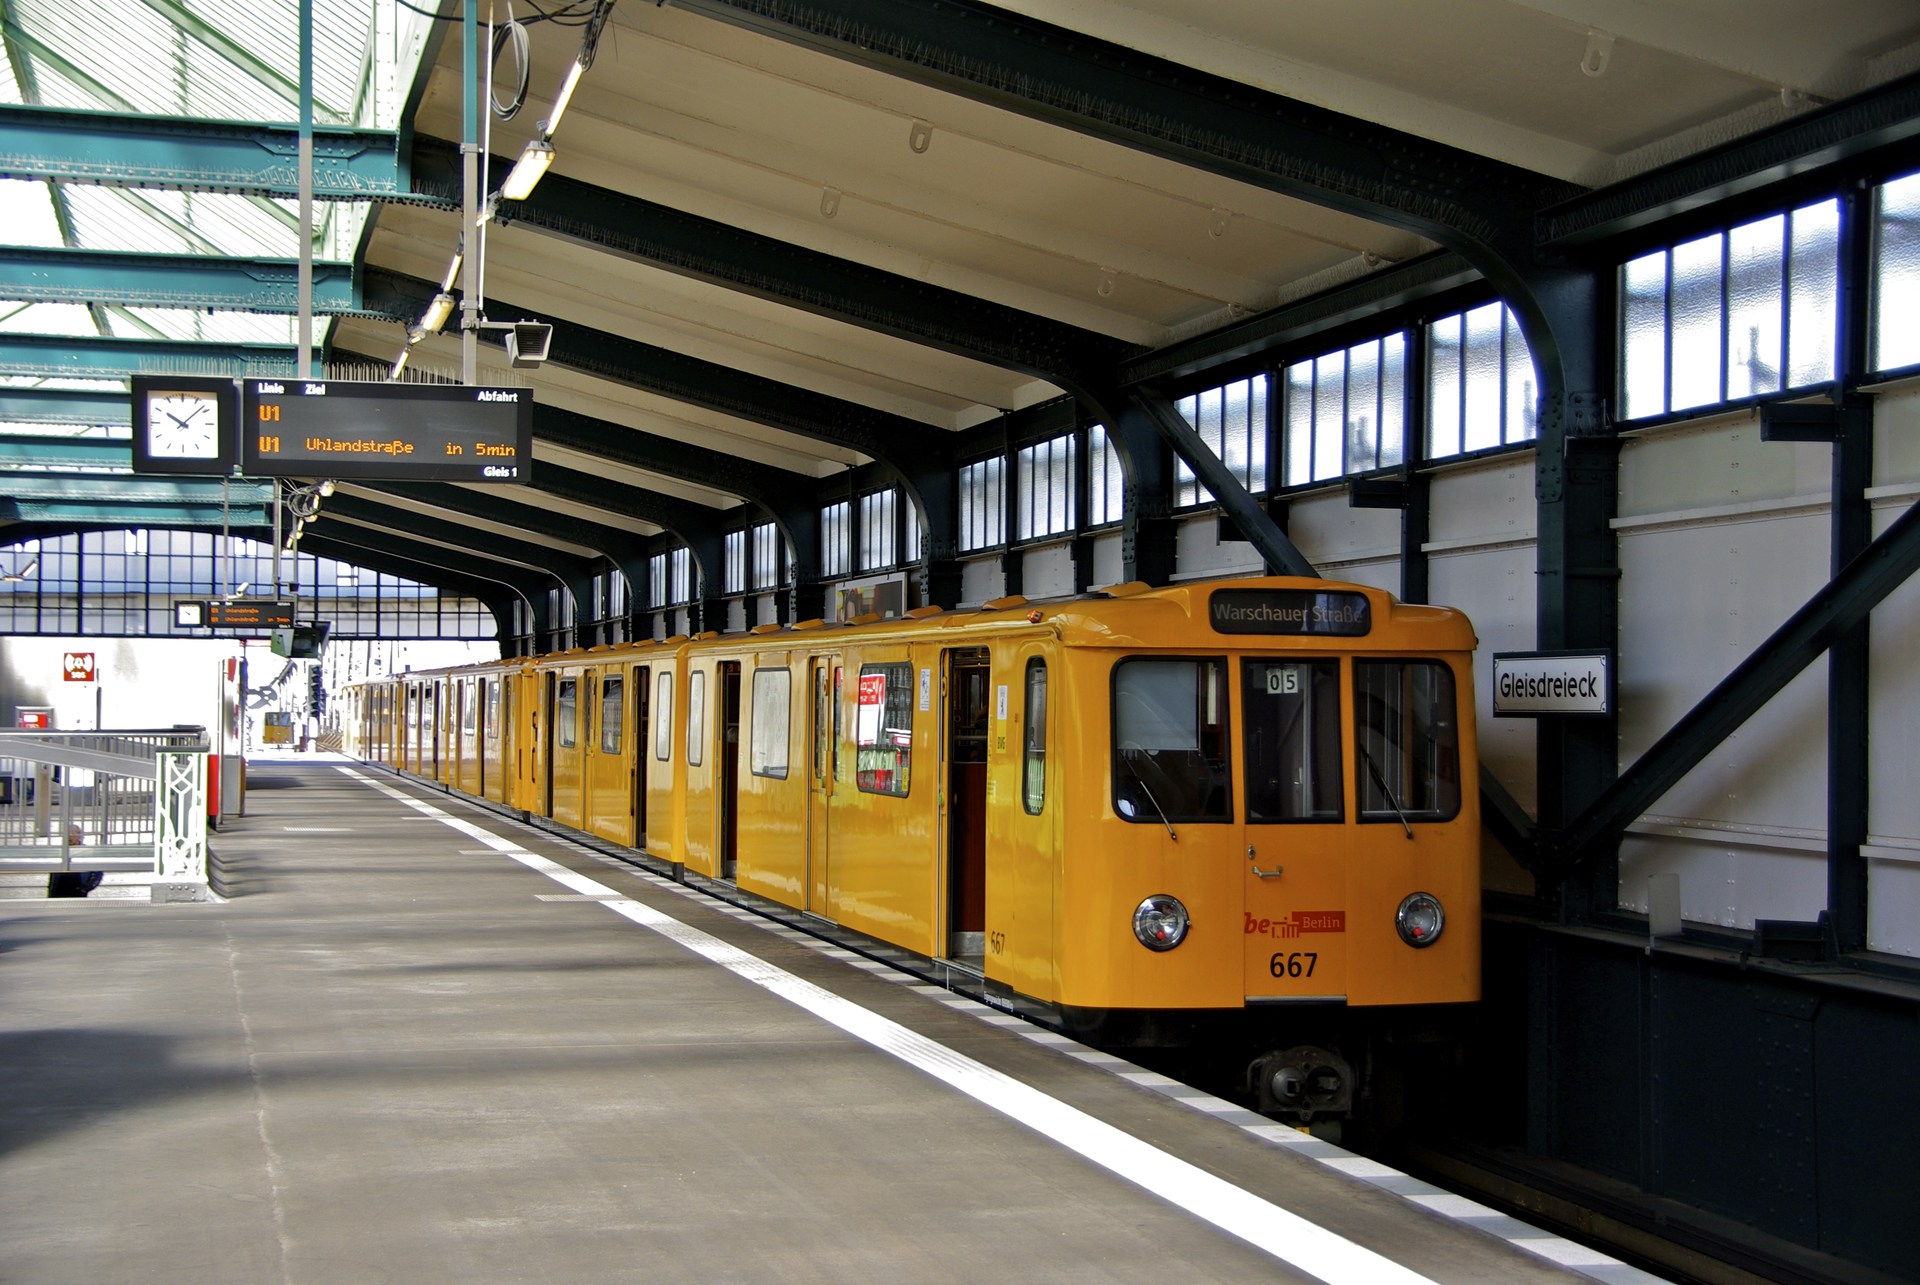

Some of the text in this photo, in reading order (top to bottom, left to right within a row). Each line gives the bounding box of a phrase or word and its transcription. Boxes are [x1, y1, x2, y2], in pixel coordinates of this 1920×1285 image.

[258, 382, 518, 402] Linie Ziel Abfahrt
[259, 405, 280, 421] U1
[259, 436, 516, 456] U1 Uhlandstraße in 5min
[483, 466, 518, 477] Gleis 1
[1213, 603, 1363, 623] Warschauer Straße
[1500, 671, 1597, 698] Gleisdreieck
[1244, 911, 1341, 934] be Berlin
[991, 930, 1005, 956] 667
[1270, 952, 1318, 978] 667
